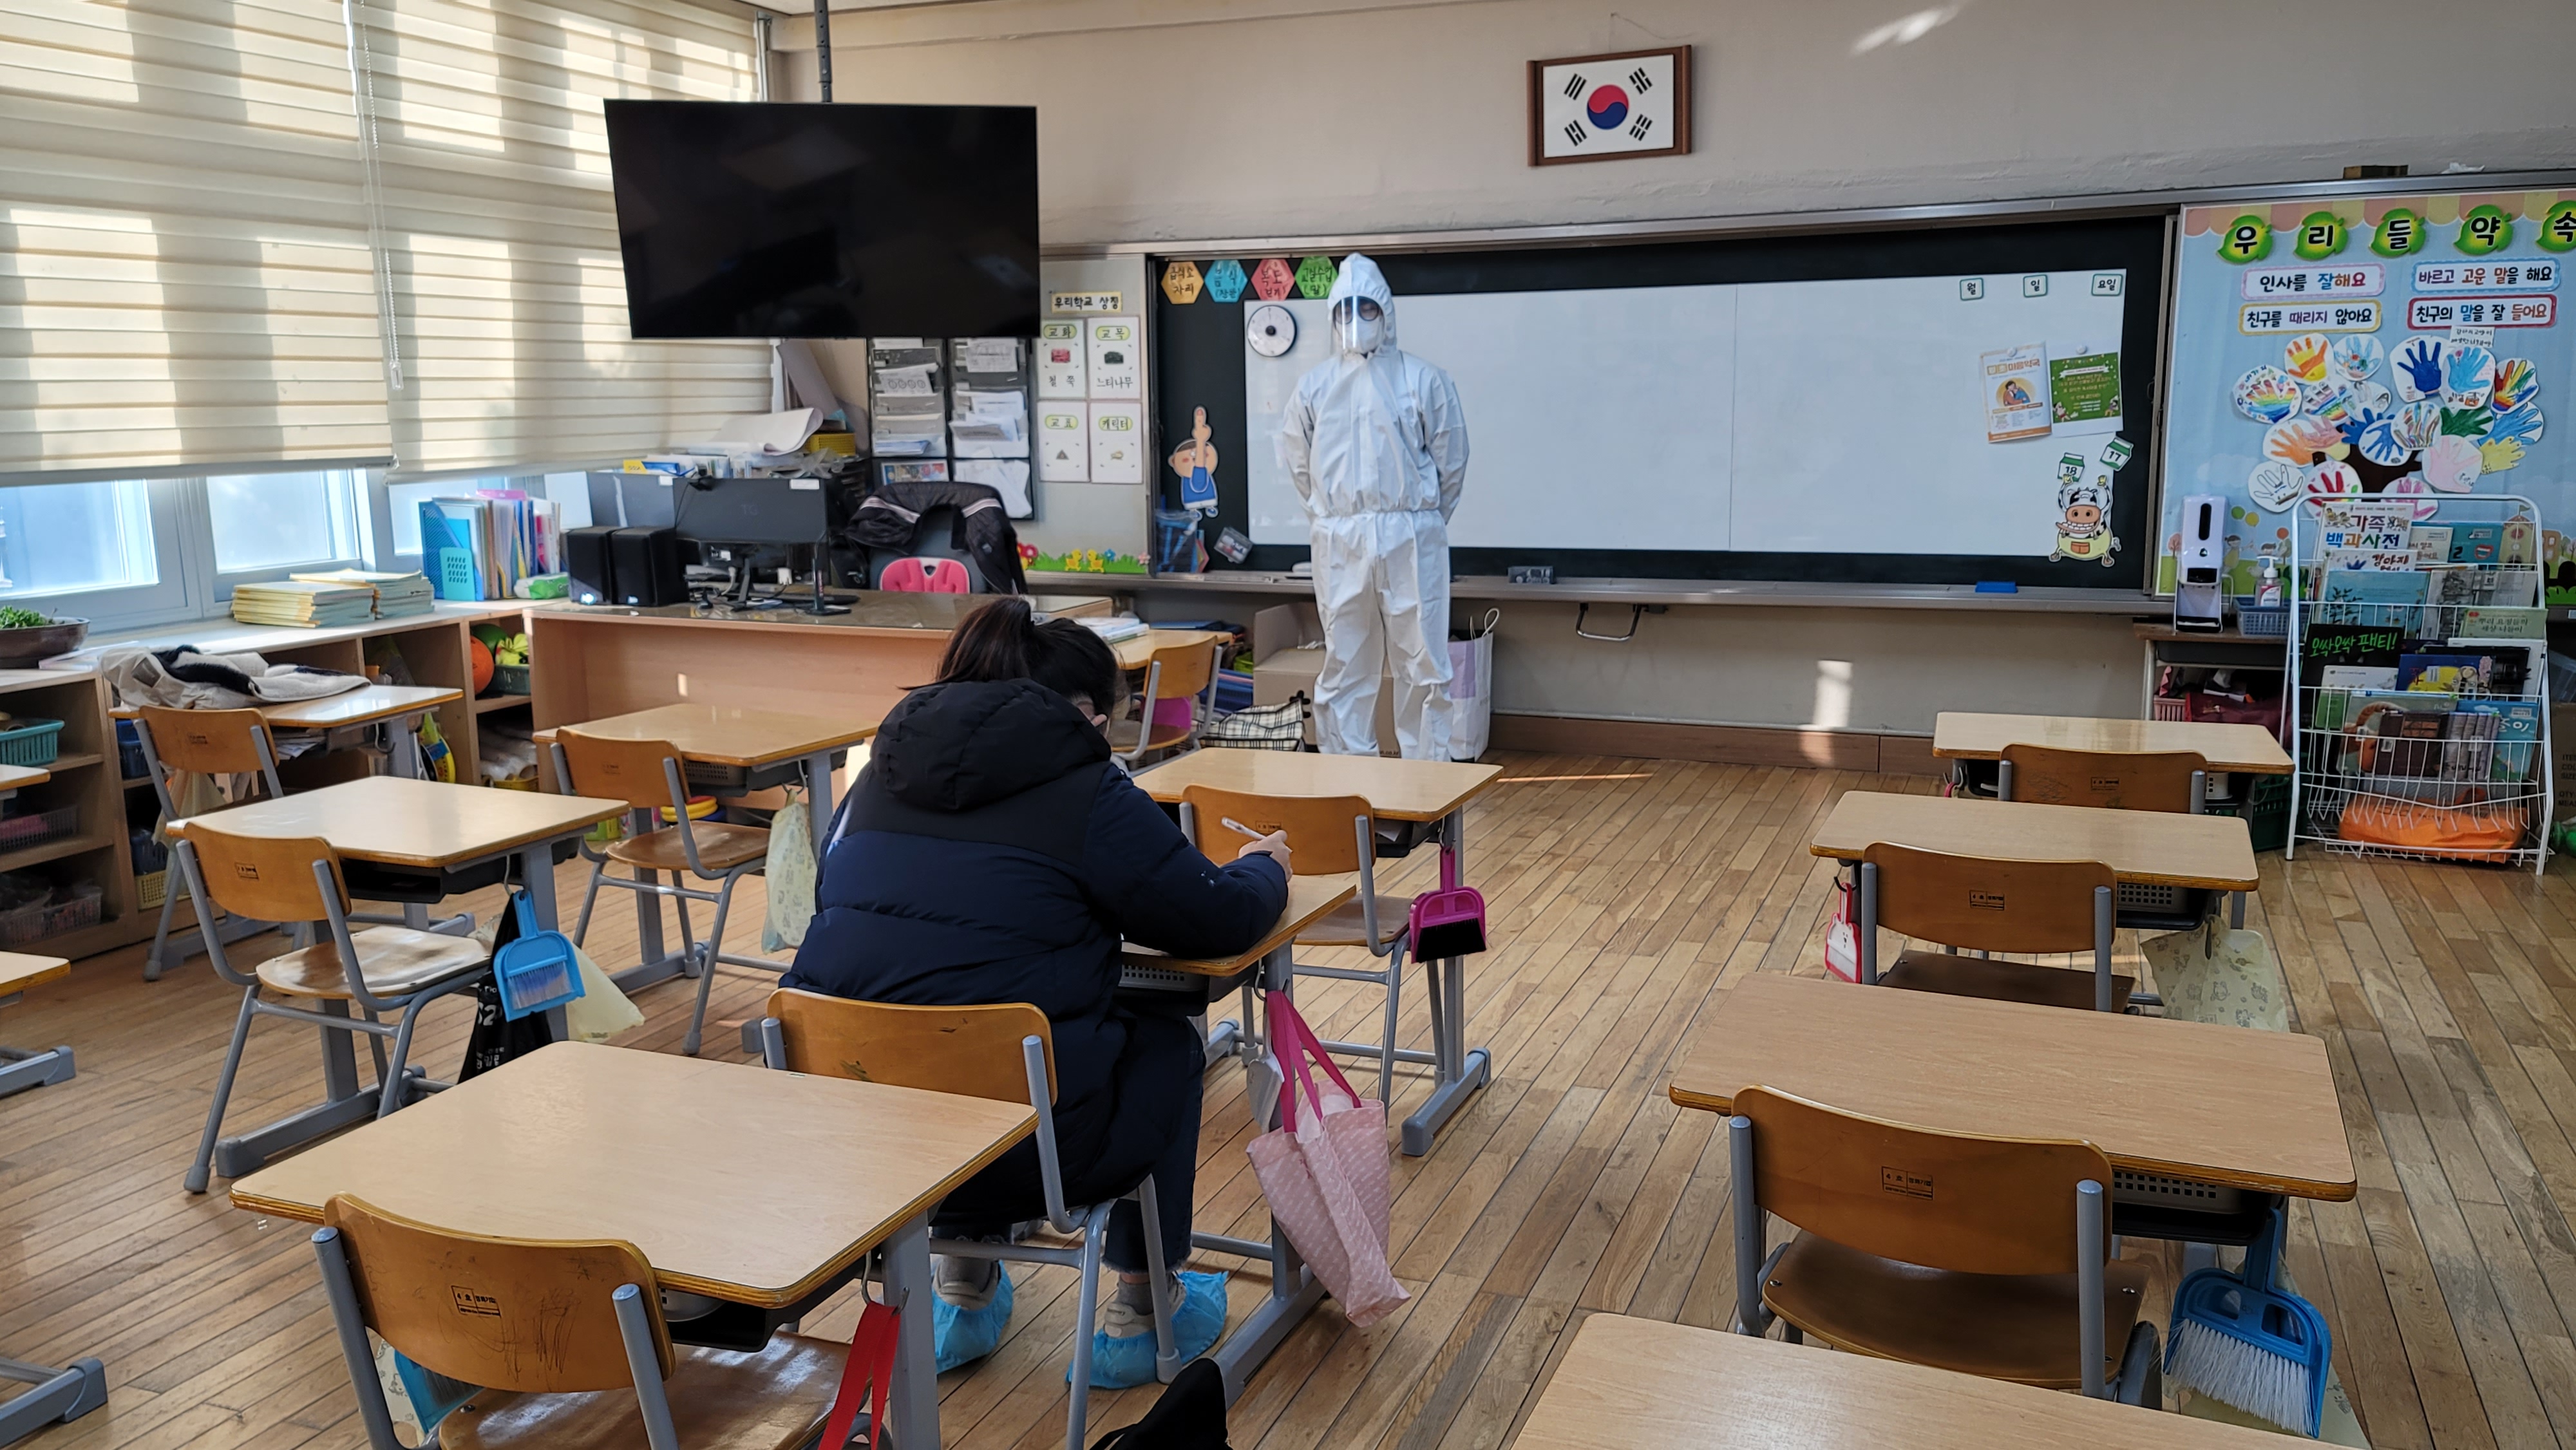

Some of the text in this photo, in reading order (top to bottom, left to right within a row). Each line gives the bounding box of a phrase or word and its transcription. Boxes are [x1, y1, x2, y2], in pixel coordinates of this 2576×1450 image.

[2260, 272, 2366, 292] 인사를 잘해요
[2418, 266, 2552, 285] 바르고 고운 말을 해요
[1967, 279, 2116, 295] 월 일 요일
[1054, 296, 1093, 310] 우리학교
[2247, 308, 2372, 328] 친구를 때리지 않아요
[2416, 303, 2547, 323] 친구의 말을 잘 들어요
[1097, 376, 1133, 389] 느티나무
[2109, 451, 2121, 462] 17
[2065, 466, 2078, 476] 18
[2351, 515, 2385, 532] 가족
[2325, 532, 2400, 550] 백과사전
[2372, 553, 2410, 567] 강아지
[2309, 632, 2398, 657] 오싹오싹 팬티!
